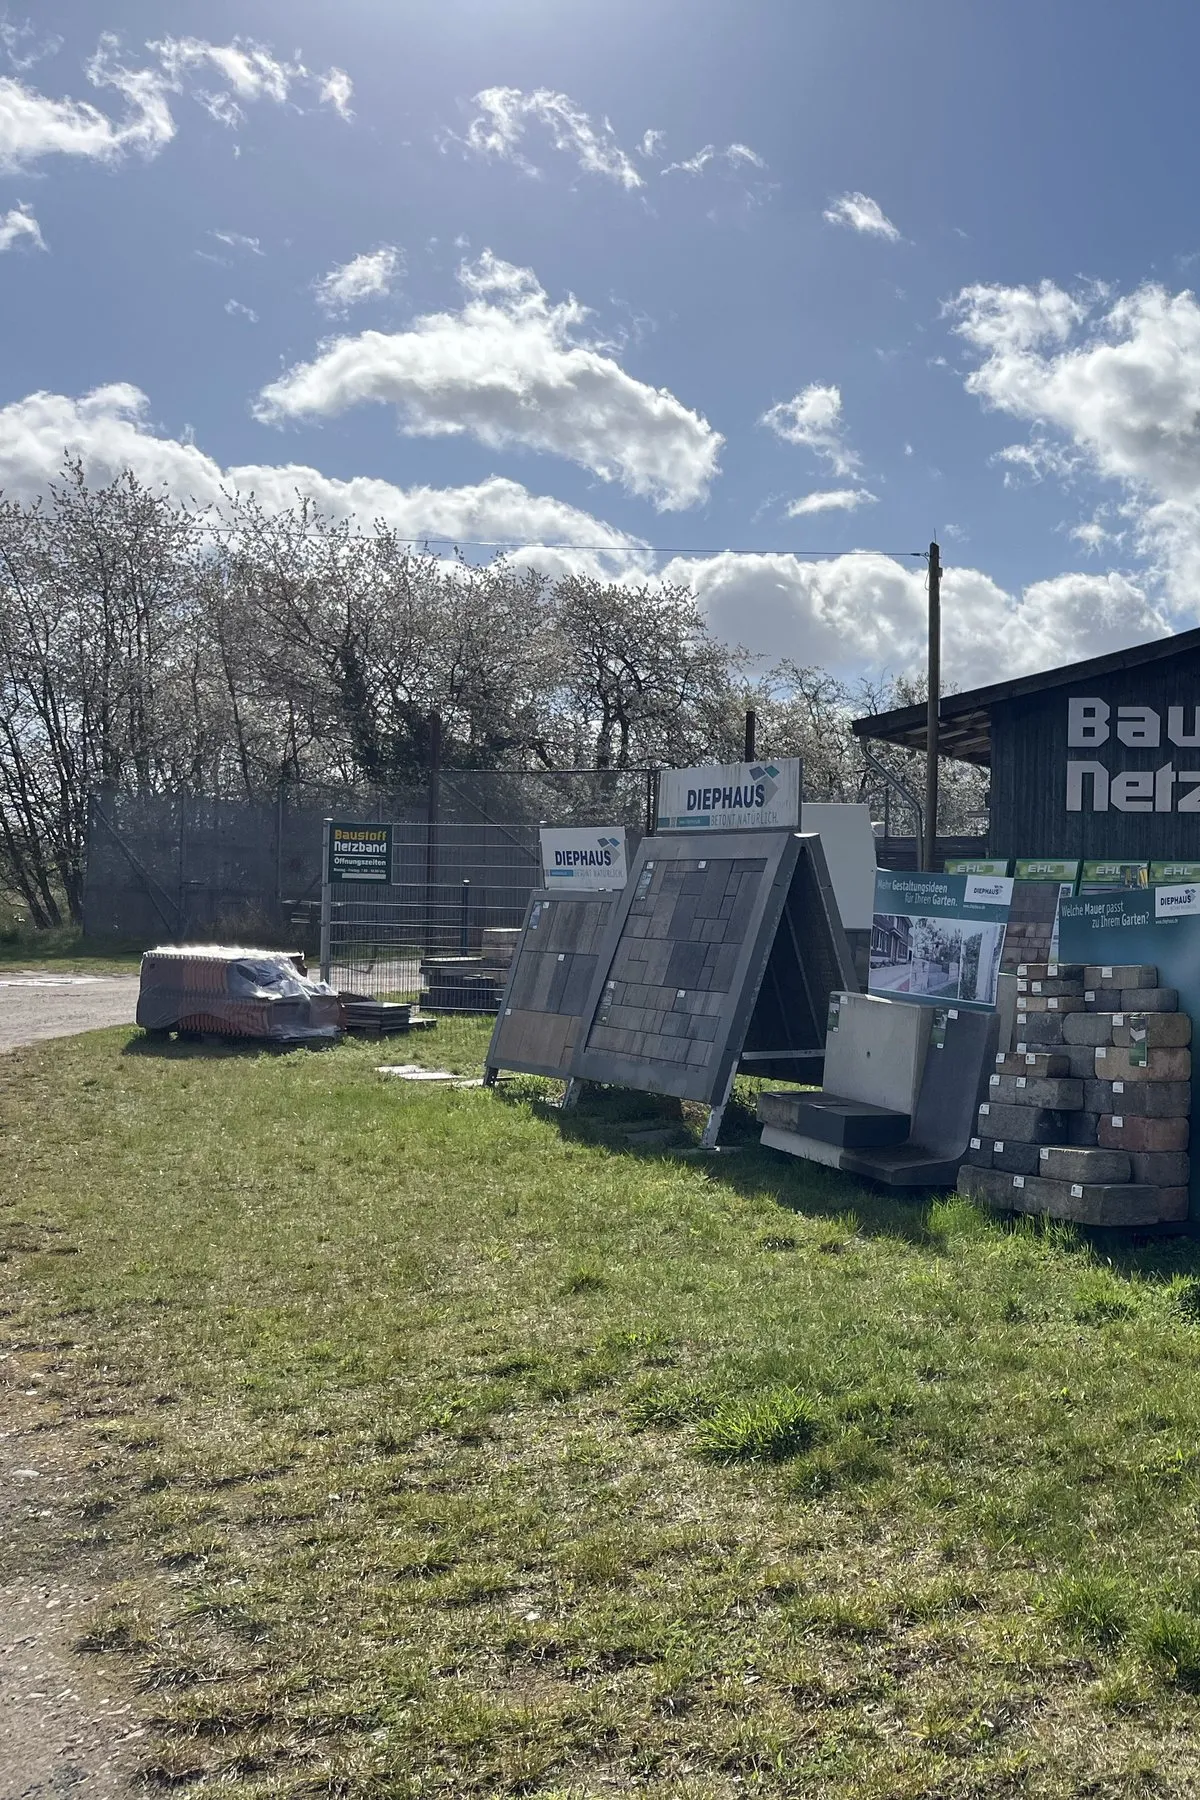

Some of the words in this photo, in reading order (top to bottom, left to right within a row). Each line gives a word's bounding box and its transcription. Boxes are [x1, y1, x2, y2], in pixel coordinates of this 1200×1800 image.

[687, 784, 765, 811] DIEPHAUS
[711, 814, 736, 826] BETONT
[334, 829, 387, 841] Baustoff
[334, 841, 387, 853] Netzband
[334, 857, 387, 867] Öffnungszeiten
[555, 850, 612, 866] DIEPHAUS
[957, 864, 984, 874] EHL
[1027, 865, 1055, 874] EHL
[1095, 866, 1121, 875] EHL
[1163, 867, 1192, 876] EHL
[877, 880, 892, 890] Mehr
[892, 880, 948, 895] Gestaltungsideen
[974, 887, 1000, 896] DIEPHAUS
[905, 892, 914, 904] für
[914, 893, 931, 905] Ihren
[932, 894, 958, 907] Garten.
[1160, 895, 1191, 906] DIEPHAUS
[1061, 904, 1084, 917] Welche
[1084, 903, 1105, 915] Mauer
[1106, 901, 1124, 914] passt
[1092, 918, 1100, 929] zu
[1100, 915, 1121, 928] Ihrem
[1121, 911, 1149, 926] Garten?
